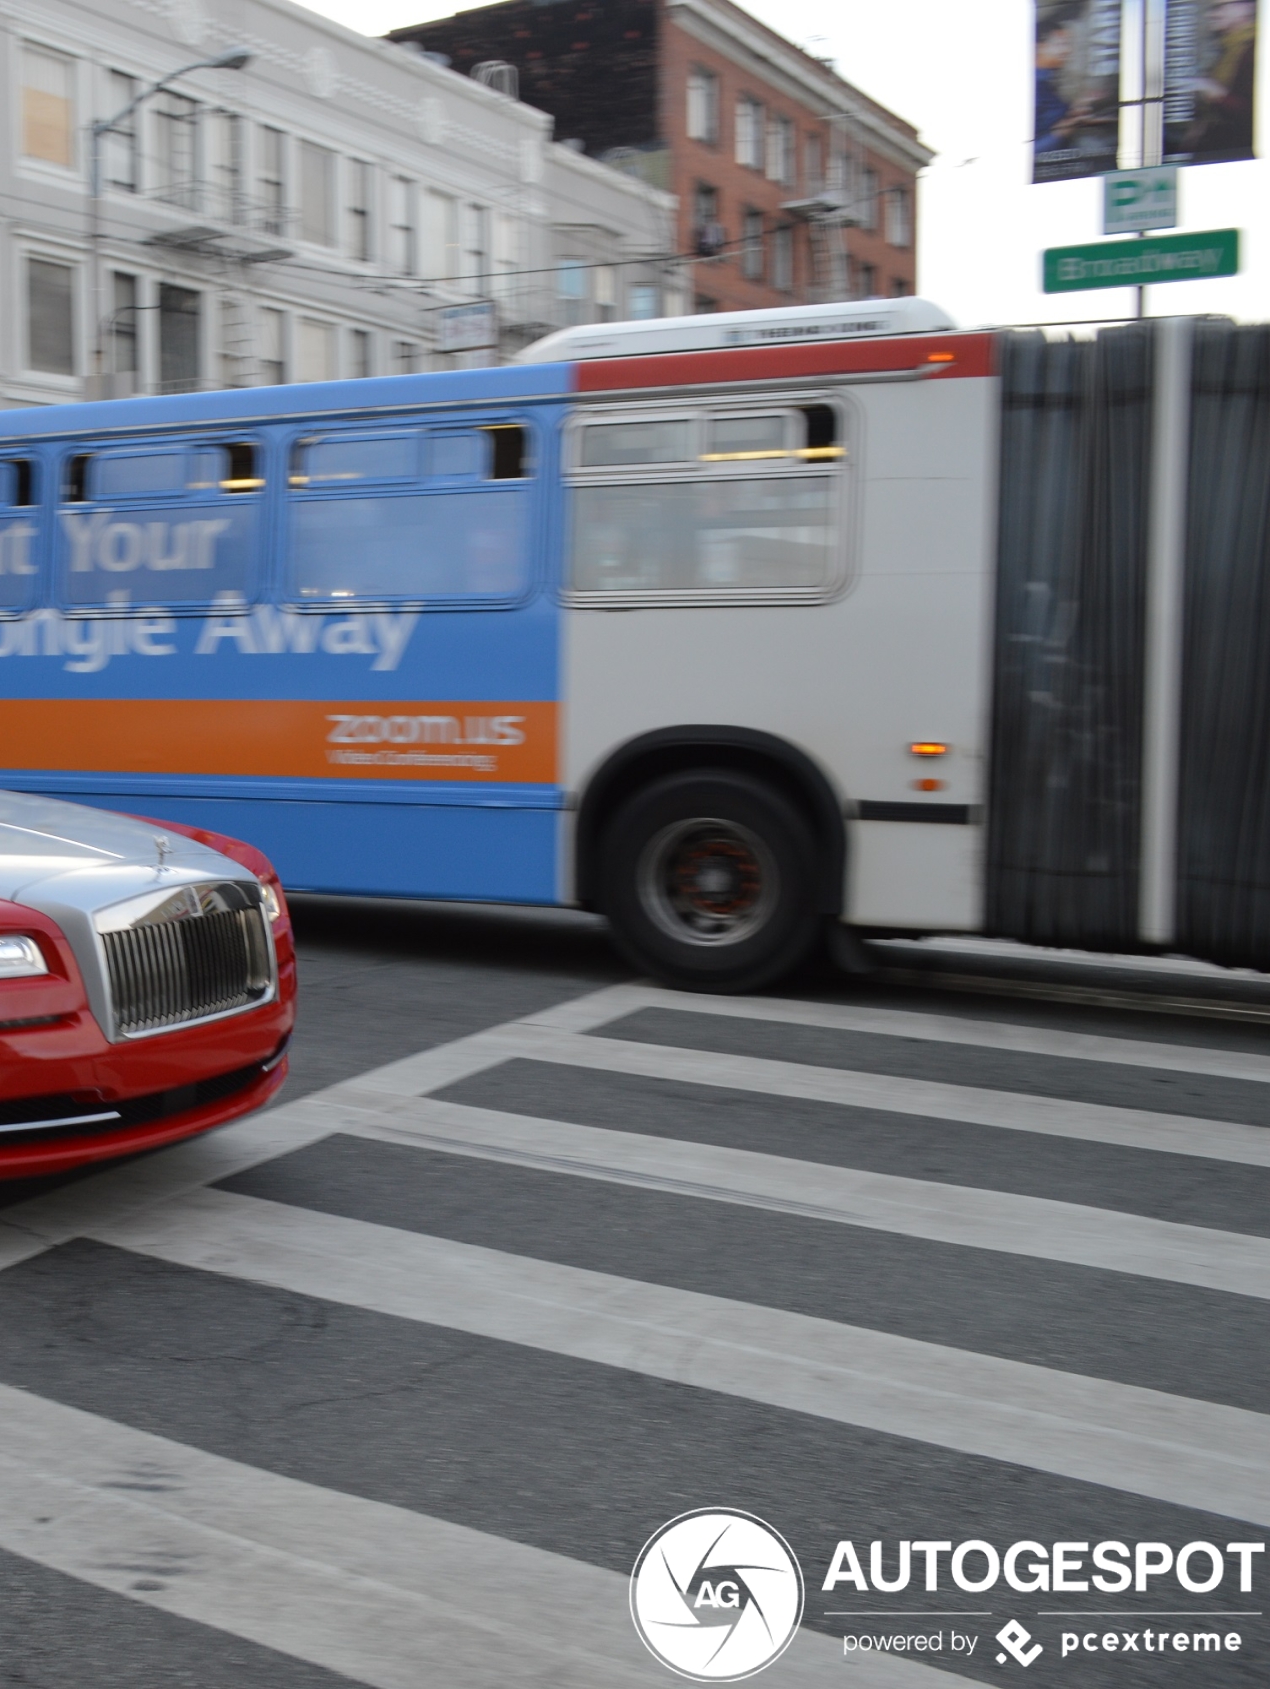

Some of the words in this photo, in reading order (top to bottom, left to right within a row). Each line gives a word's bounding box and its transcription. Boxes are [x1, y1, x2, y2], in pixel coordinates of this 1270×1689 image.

[1056, 249, 1224, 281] Broadway
[60, 507, 232, 573] Your
[194, 590, 428, 671] Away
[325, 714, 527, 746] zoom.us
